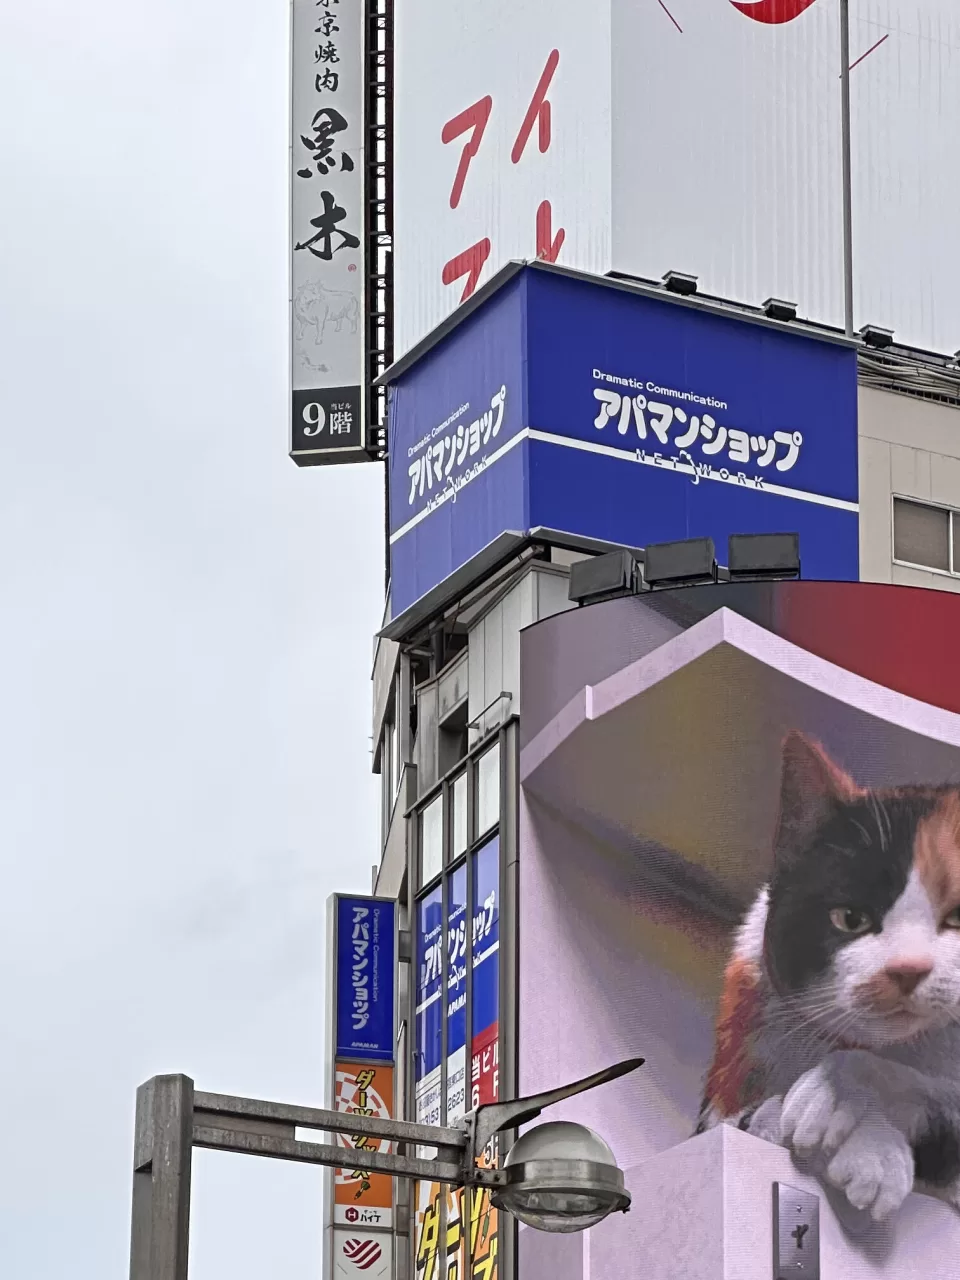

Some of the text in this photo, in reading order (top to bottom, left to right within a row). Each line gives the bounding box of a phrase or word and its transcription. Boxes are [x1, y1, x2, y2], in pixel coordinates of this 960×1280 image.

[294, 0, 361, 261] 京焼肉 黒木
[442, 49, 560, 210] アイ
[408, 384, 506, 505] アパマンショップ
[592, 369, 728, 410] Dramatic Communication
[593, 388, 803, 472] アパマンショップ
[352, 906, 370, 1030] アパマンショップ
